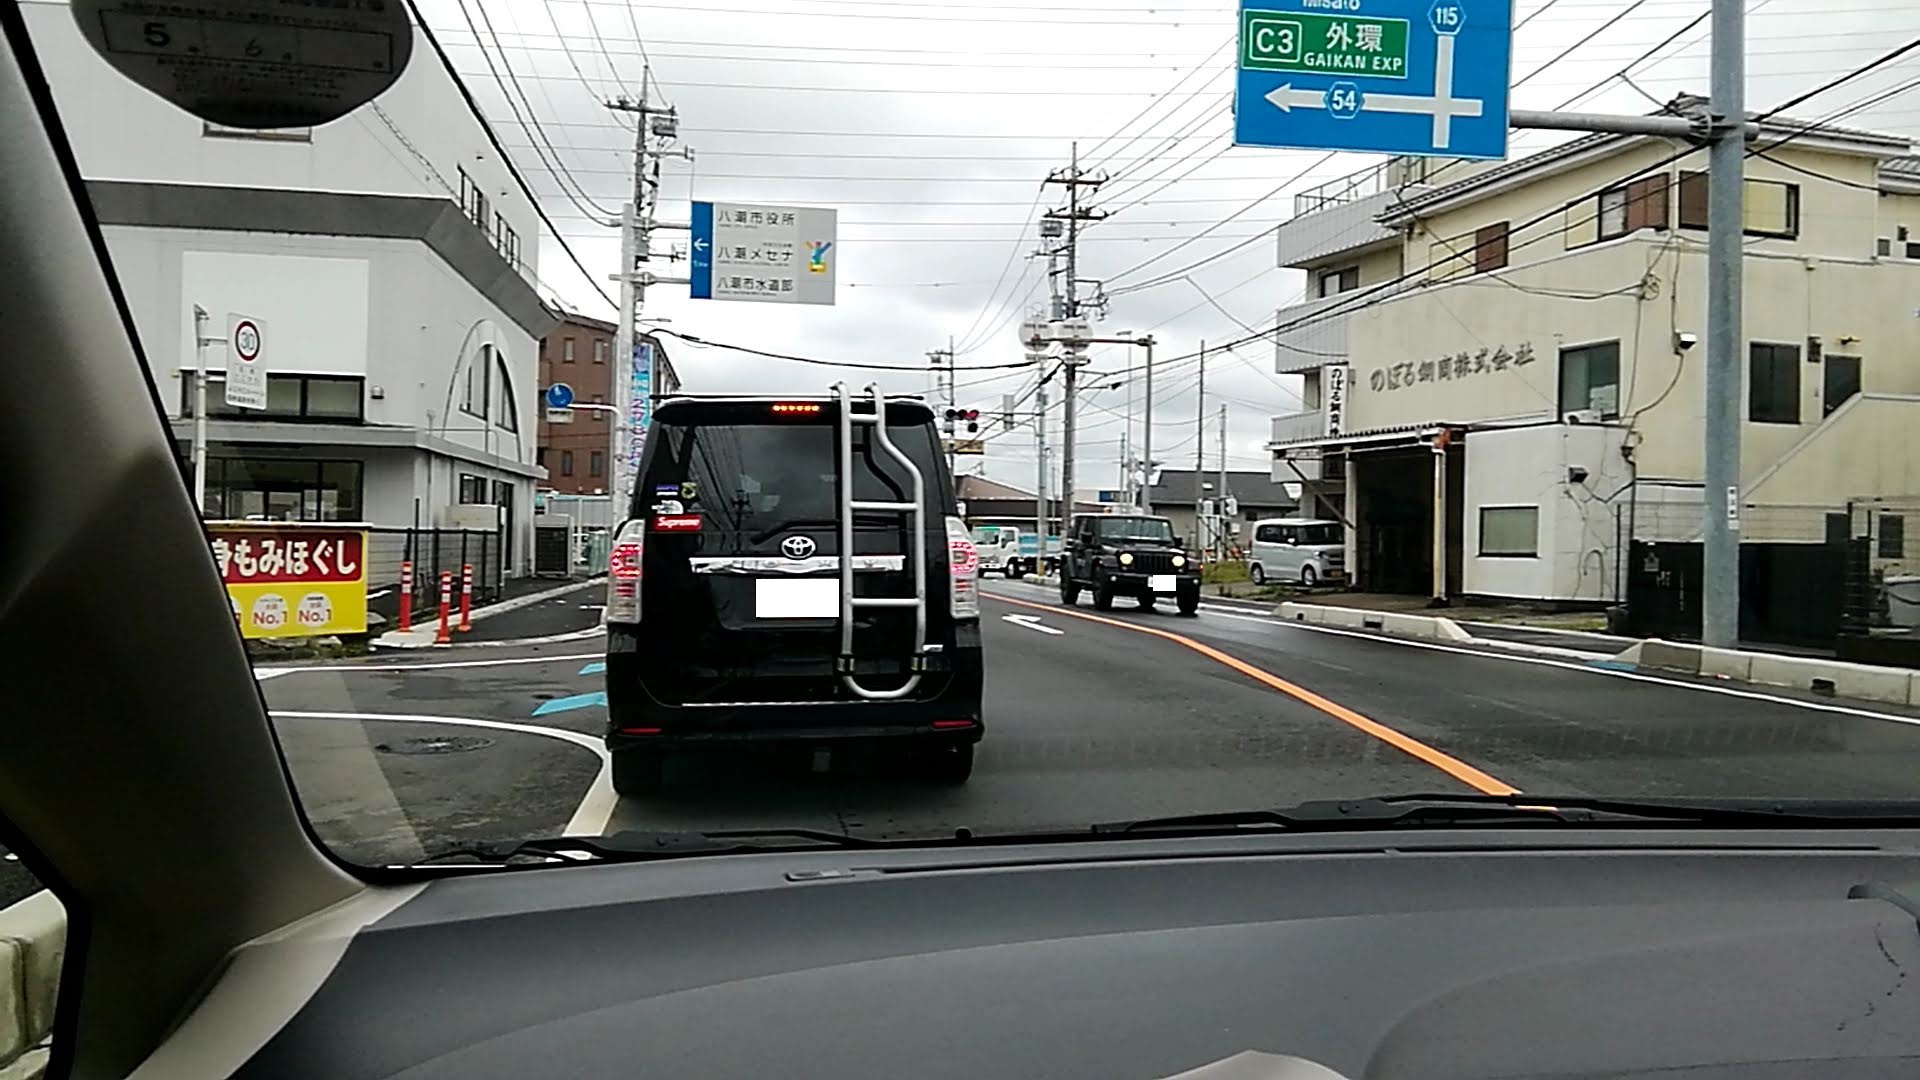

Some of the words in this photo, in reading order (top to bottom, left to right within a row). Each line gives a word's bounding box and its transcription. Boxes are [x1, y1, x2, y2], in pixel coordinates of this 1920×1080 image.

[1435, 7, 1460, 26] 115
[143, 22, 171, 47] 5
[1255, 28, 1294, 54] C3
[1326, 22, 1383, 52] 外環
[1303, 52, 1366, 70] GAIKAN
[1372, 57, 1402, 72] EXP
[1331, 89, 1356, 111] 54
[239, 330, 256, 351] 30
[252, 611, 289, 625] No.1
[298, 608, 333, 623] No.1
